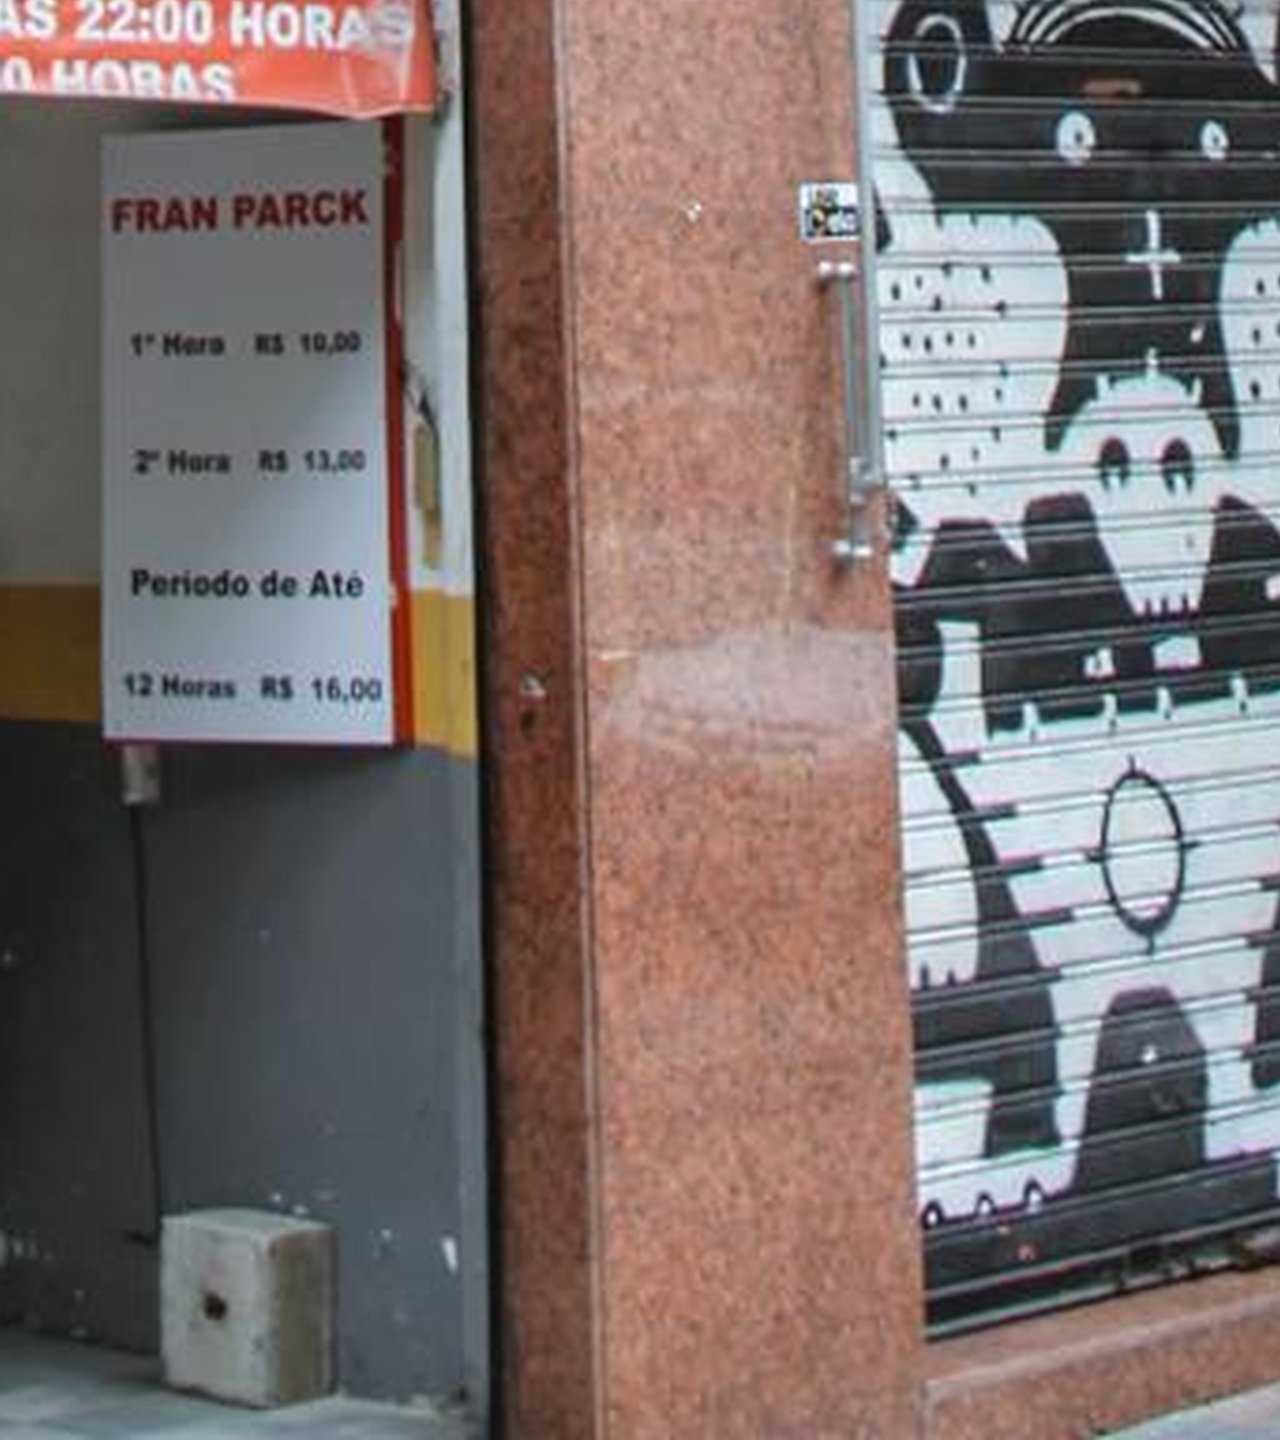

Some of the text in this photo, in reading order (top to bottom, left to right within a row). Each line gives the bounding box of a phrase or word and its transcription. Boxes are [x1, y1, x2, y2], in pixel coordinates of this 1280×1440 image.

[230, 2, 416, 58] HORAS
[112, 190, 368, 233] FRAN PARCK
[163, 332, 225, 356] Hora
[254, 333, 284, 355] R$
[168, 449, 231, 475] Hora
[258, 449, 288, 473] R$
[260, 569, 298, 598] de
[309, 569, 364, 598] Até
[125, 673, 383, 704] 12 Horas R$ 16,00
